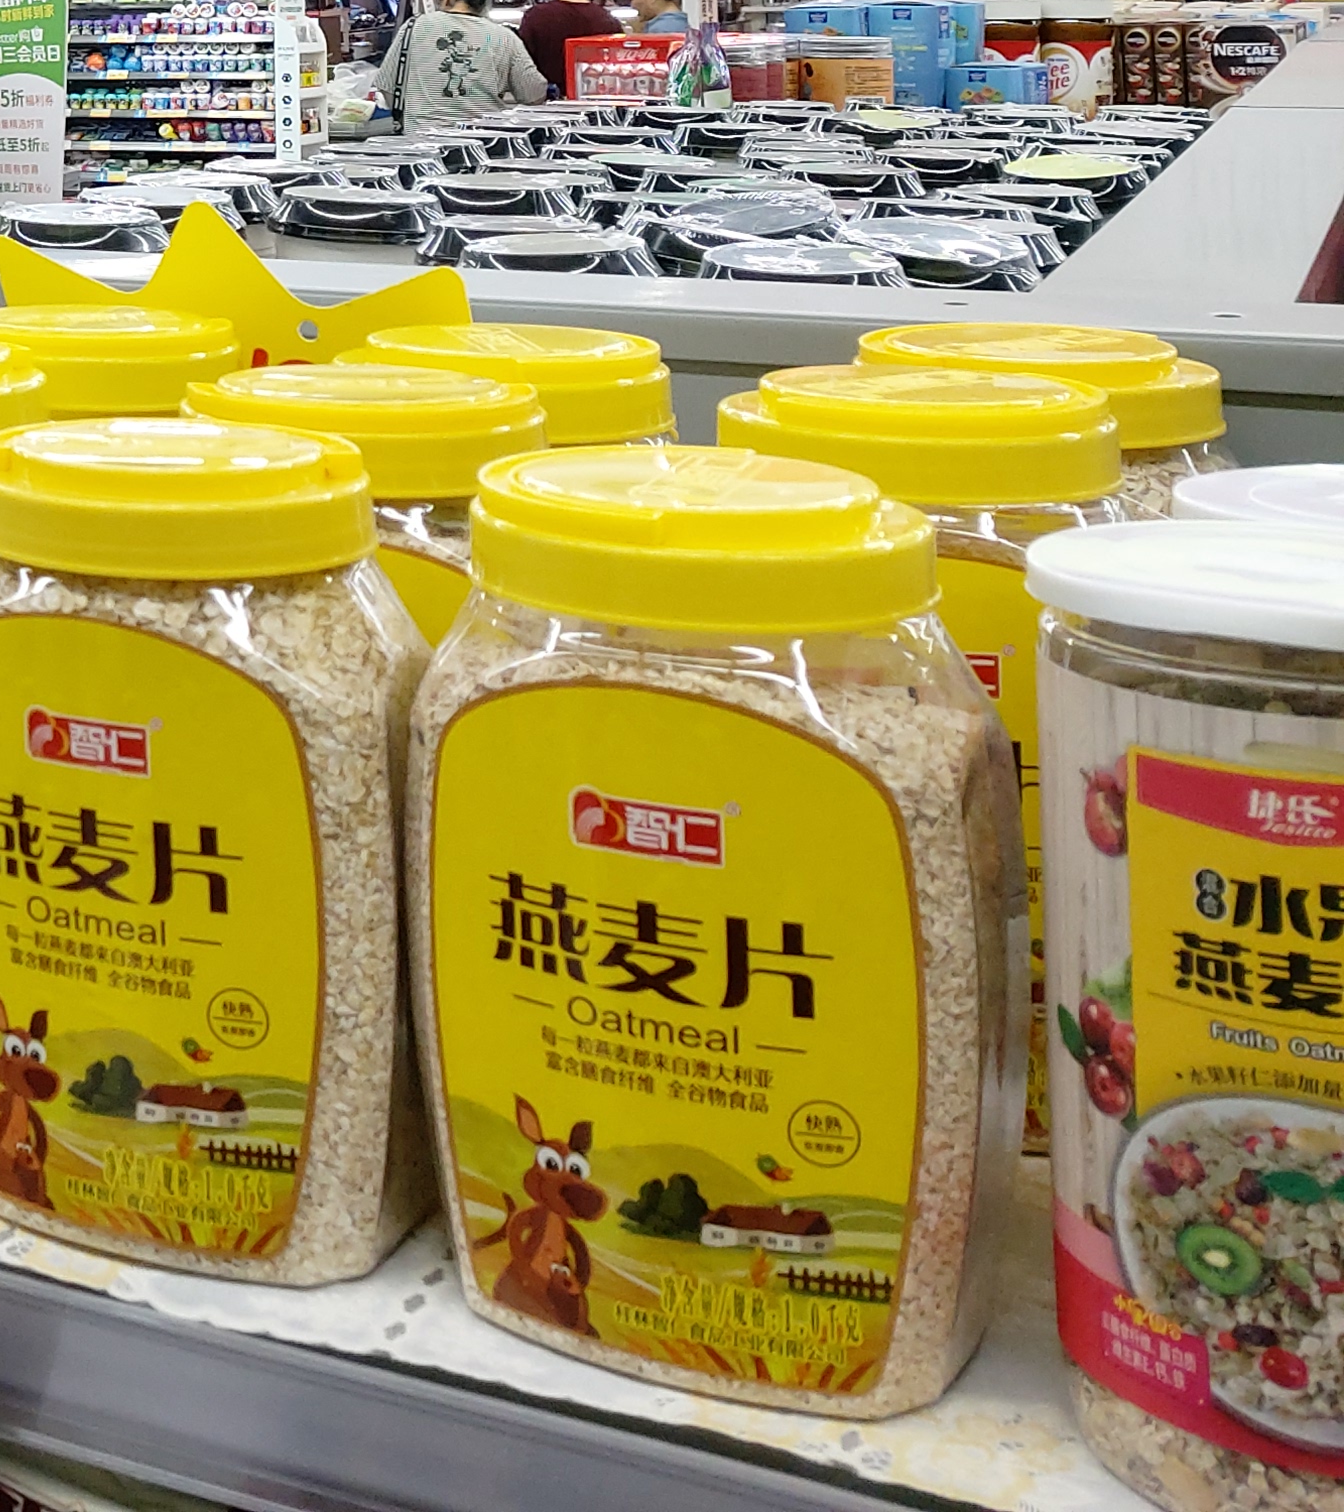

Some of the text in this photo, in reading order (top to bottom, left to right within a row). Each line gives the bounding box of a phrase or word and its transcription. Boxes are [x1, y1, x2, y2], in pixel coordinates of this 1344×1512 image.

[68, 720, 147, 768] 智仁
[624, 804, 722, 858] 智仁
[24, 893, 168, 949] Oatmeal
[488, 870, 835, 1021] 燕麦片
[565, 994, 742, 1056] Oatmeal
[1210, 1020, 1279, 1053] Fruits
[540, 1025, 774, 1091] 每一粒燕麦都来自澳大利亚
[544, 1048, 771, 1115] 富含膳食纤维 全谷物食品
